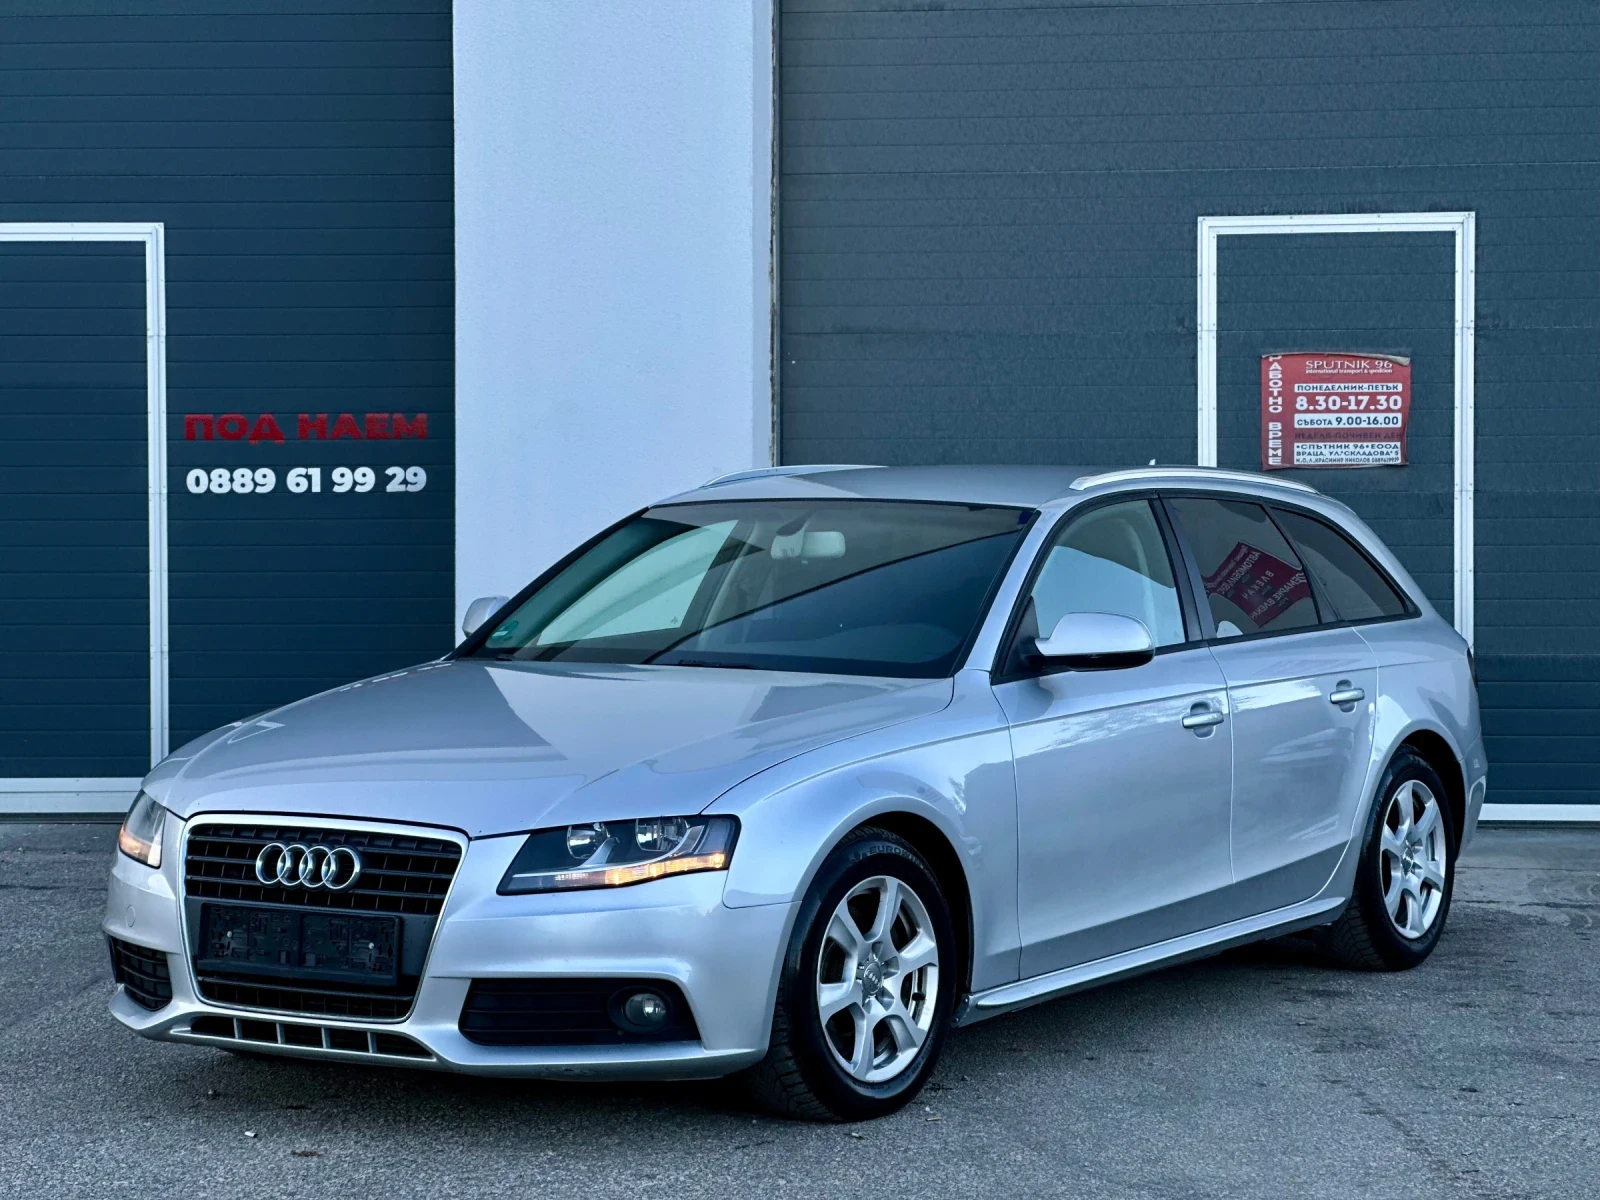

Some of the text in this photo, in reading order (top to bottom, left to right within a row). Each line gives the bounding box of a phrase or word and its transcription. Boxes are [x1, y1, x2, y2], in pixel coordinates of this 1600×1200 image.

[1305, 360, 1393, 369] SPUTNIK 96
[1297, 384, 1399, 392] ПОНЕДЕЛНИК-ПЕТЪК
[1295, 395, 1402, 411] 8.30-17.30
[184, 412, 428, 445] ПОД НАЕМ
[1335, 416, 1399, 426] 9.00-16.00
[1268, 422, 1283, 465] ВРЕМЕ
[186, 466, 427, 494] 0889 61 99 29
